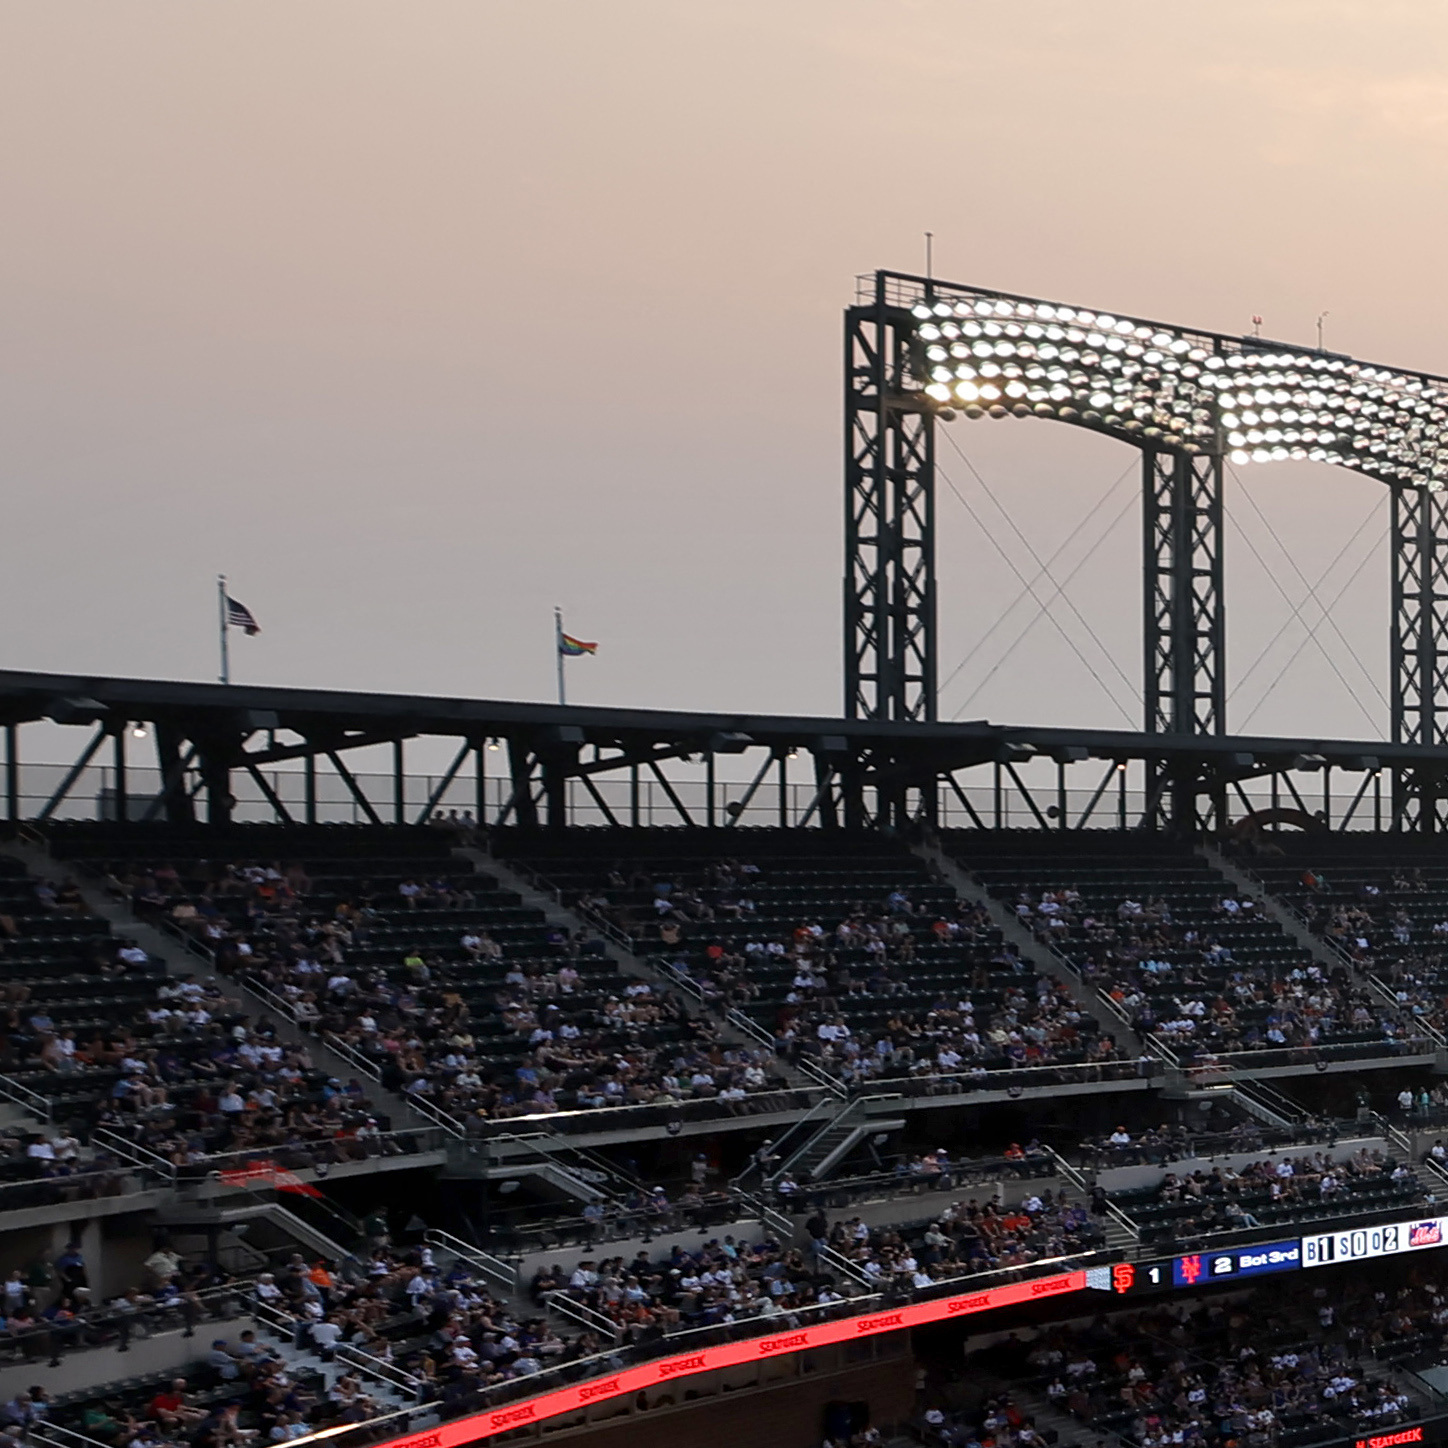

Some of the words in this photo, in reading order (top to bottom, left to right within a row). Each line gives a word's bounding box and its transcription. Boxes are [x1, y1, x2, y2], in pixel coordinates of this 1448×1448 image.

[1340, 1238, 1348, 1255] S
[1384, 1227, 1397, 1251] 2
[1307, 1242, 1315, 1260] B
[1214, 1257, 1232, 1273] 2
[1240, 1255, 1268, 1268] Bot
[1270, 1249, 1299, 1264] 3rd
[1149, 1267, 1160, 1283] 1
